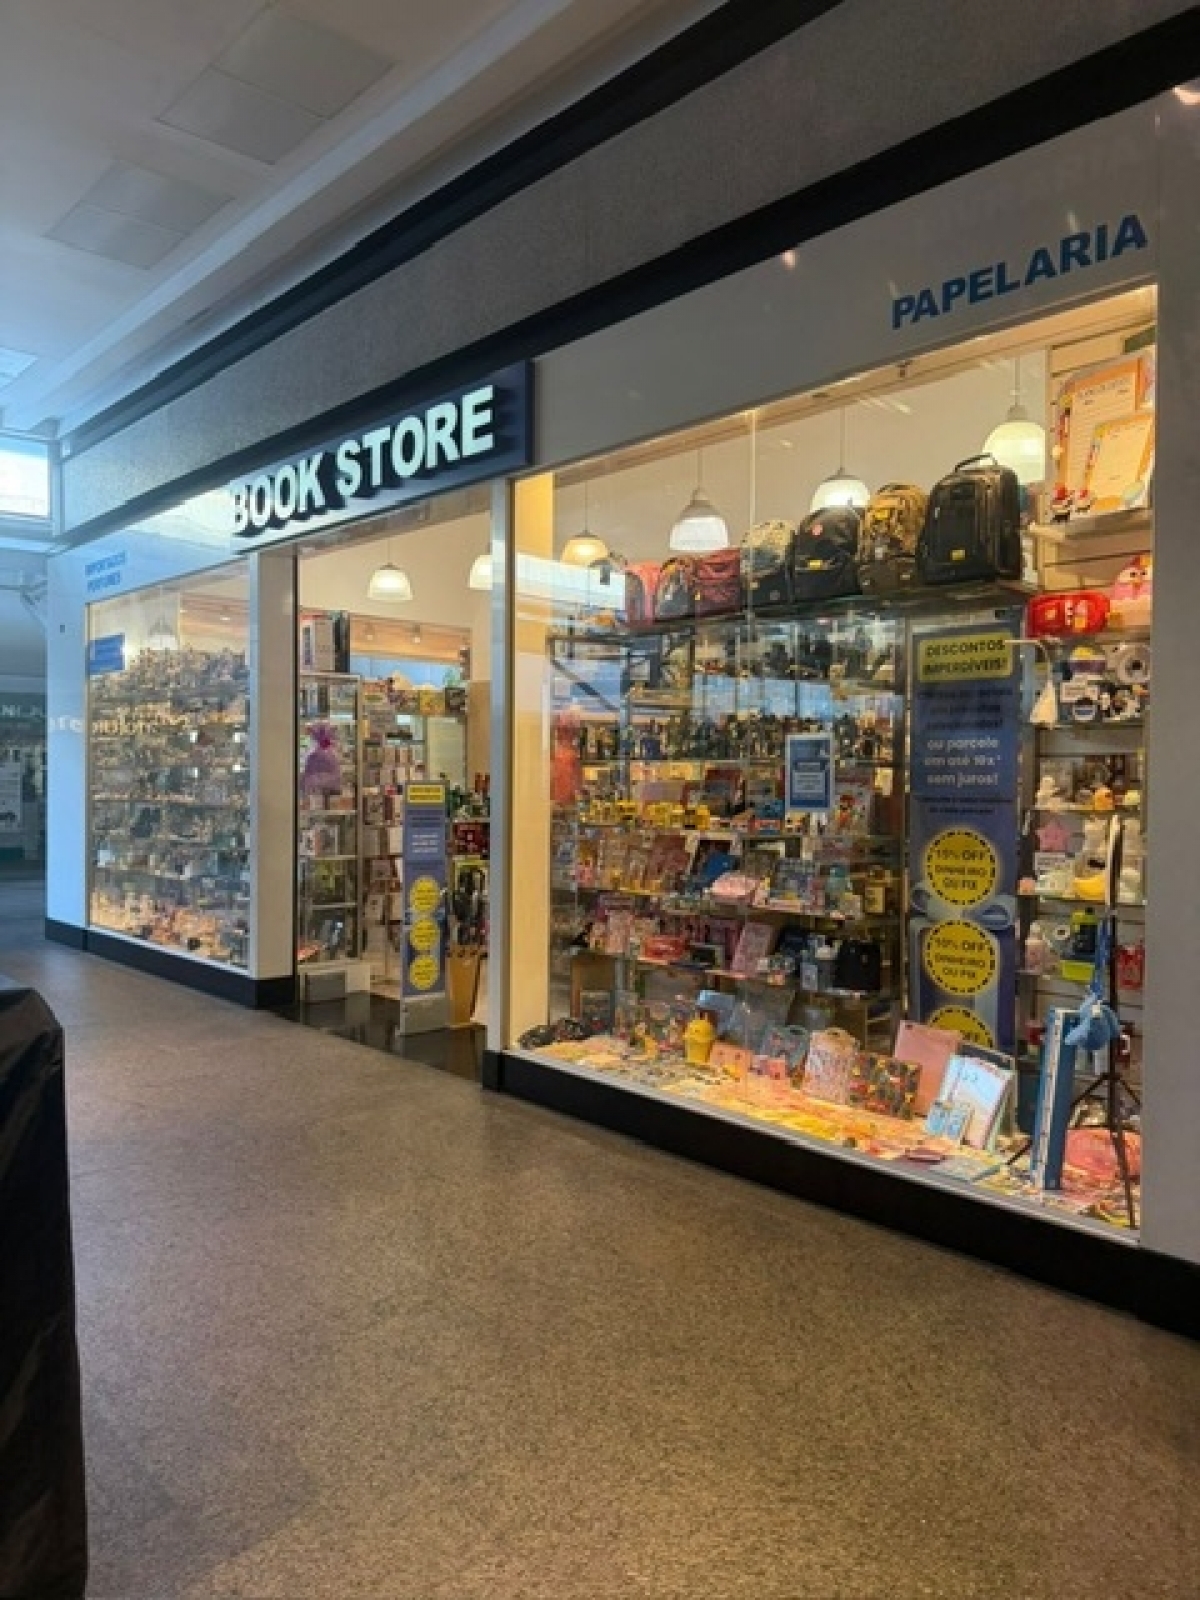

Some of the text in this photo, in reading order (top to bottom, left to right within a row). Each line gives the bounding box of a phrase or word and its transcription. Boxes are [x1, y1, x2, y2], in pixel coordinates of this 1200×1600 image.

[891, 213, 1149, 330] PAPELARIA
[230, 384, 495, 535] BOOK STORE
[926, 637, 1007, 657] DESCONTOS
[946, 736, 999, 753] parcele
[962, 849, 987, 861] OFF
